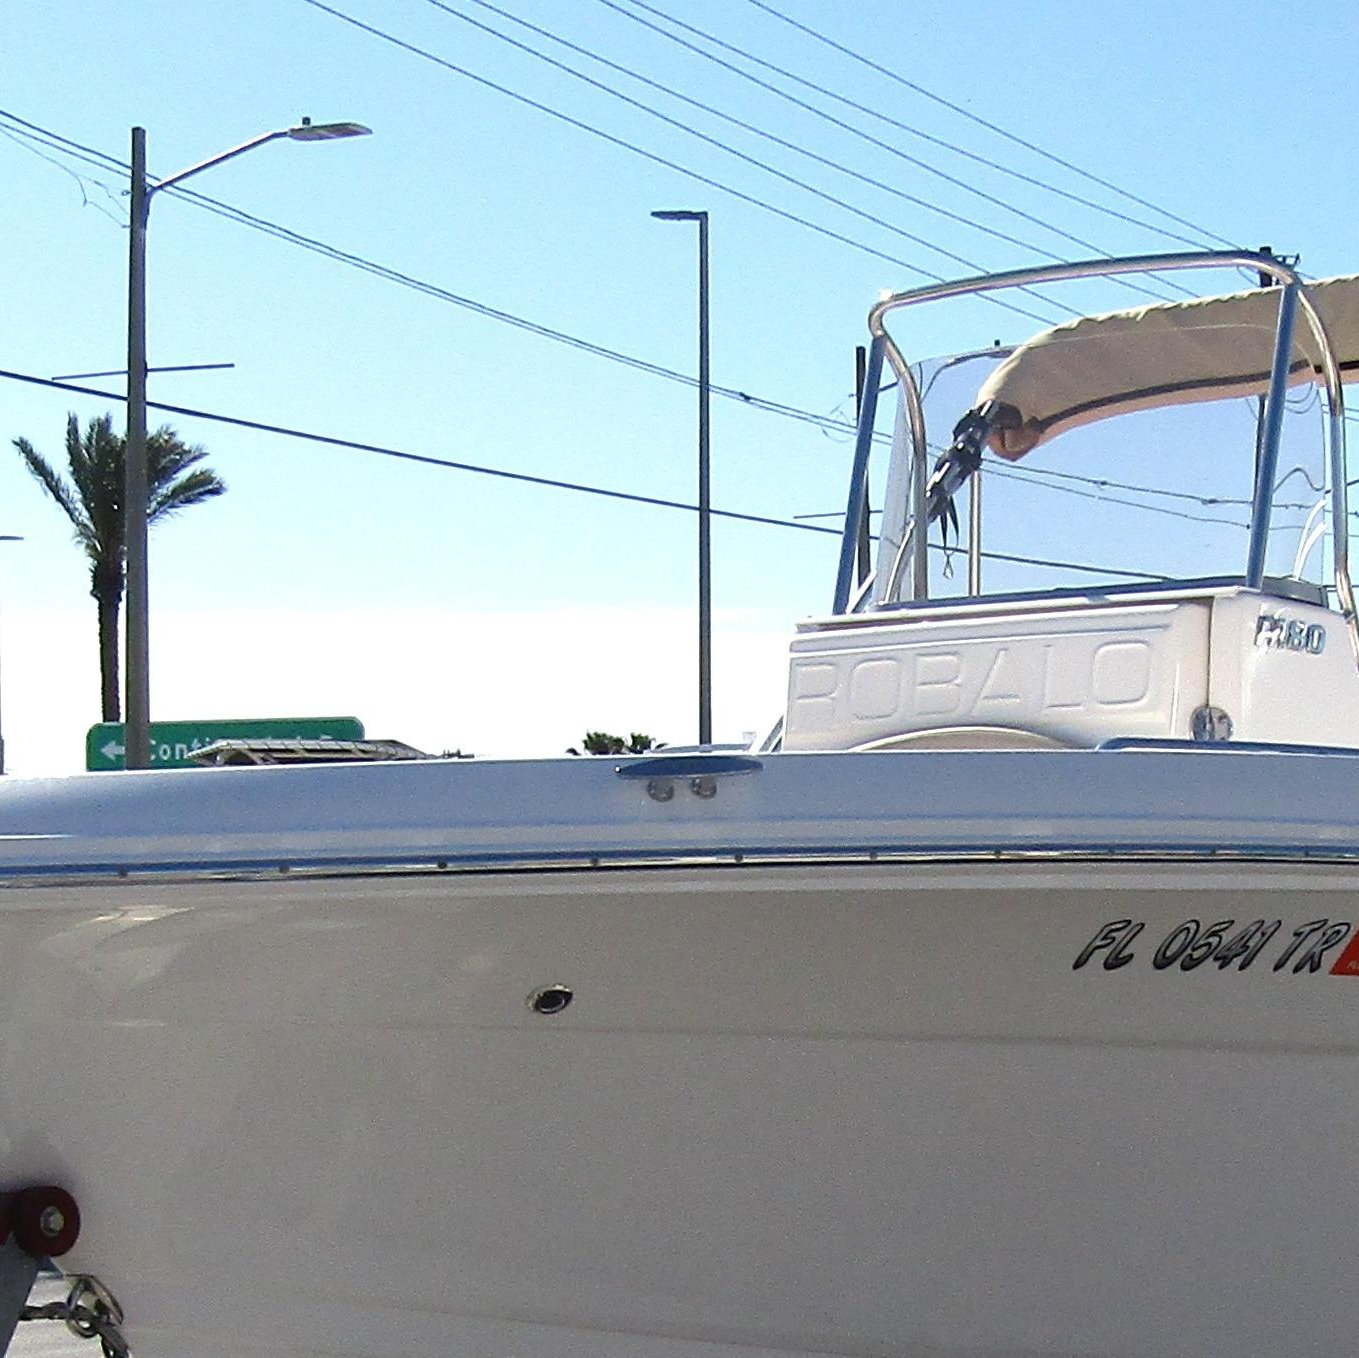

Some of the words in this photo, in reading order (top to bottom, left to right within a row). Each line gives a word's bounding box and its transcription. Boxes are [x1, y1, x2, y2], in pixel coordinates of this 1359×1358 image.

[792, 639, 1155, 724] ROBALO
[1071, 918, 1146, 970] FL
[1152, 918, 1282, 972] 0541
[1272, 918, 1351, 974] TR
